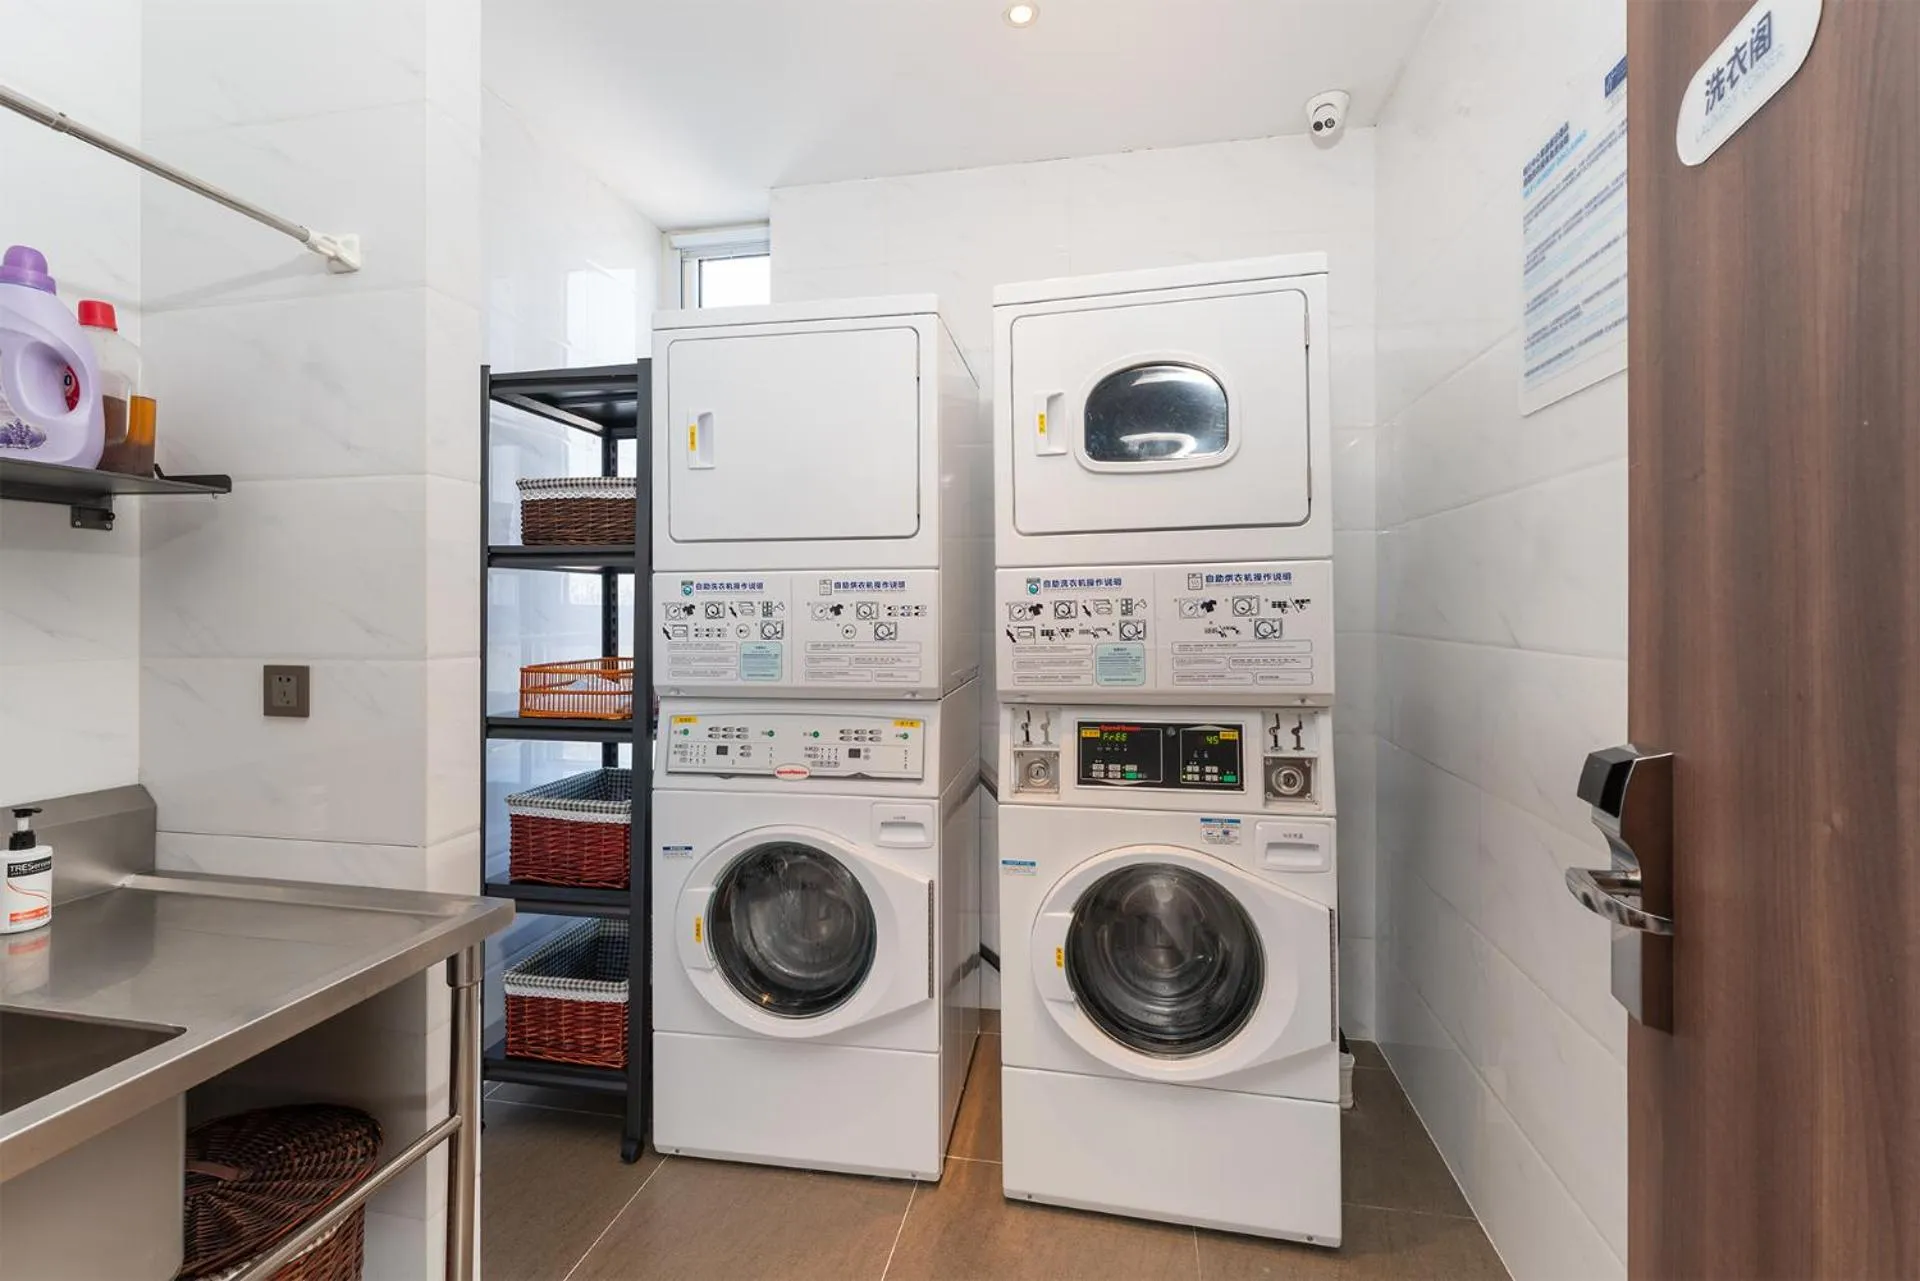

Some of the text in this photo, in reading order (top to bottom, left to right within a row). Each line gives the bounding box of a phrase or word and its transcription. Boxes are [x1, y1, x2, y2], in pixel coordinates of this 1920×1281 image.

[1704, 9, 1773, 116] 洗衣阁
[1206, 735, 1220, 745] 45
